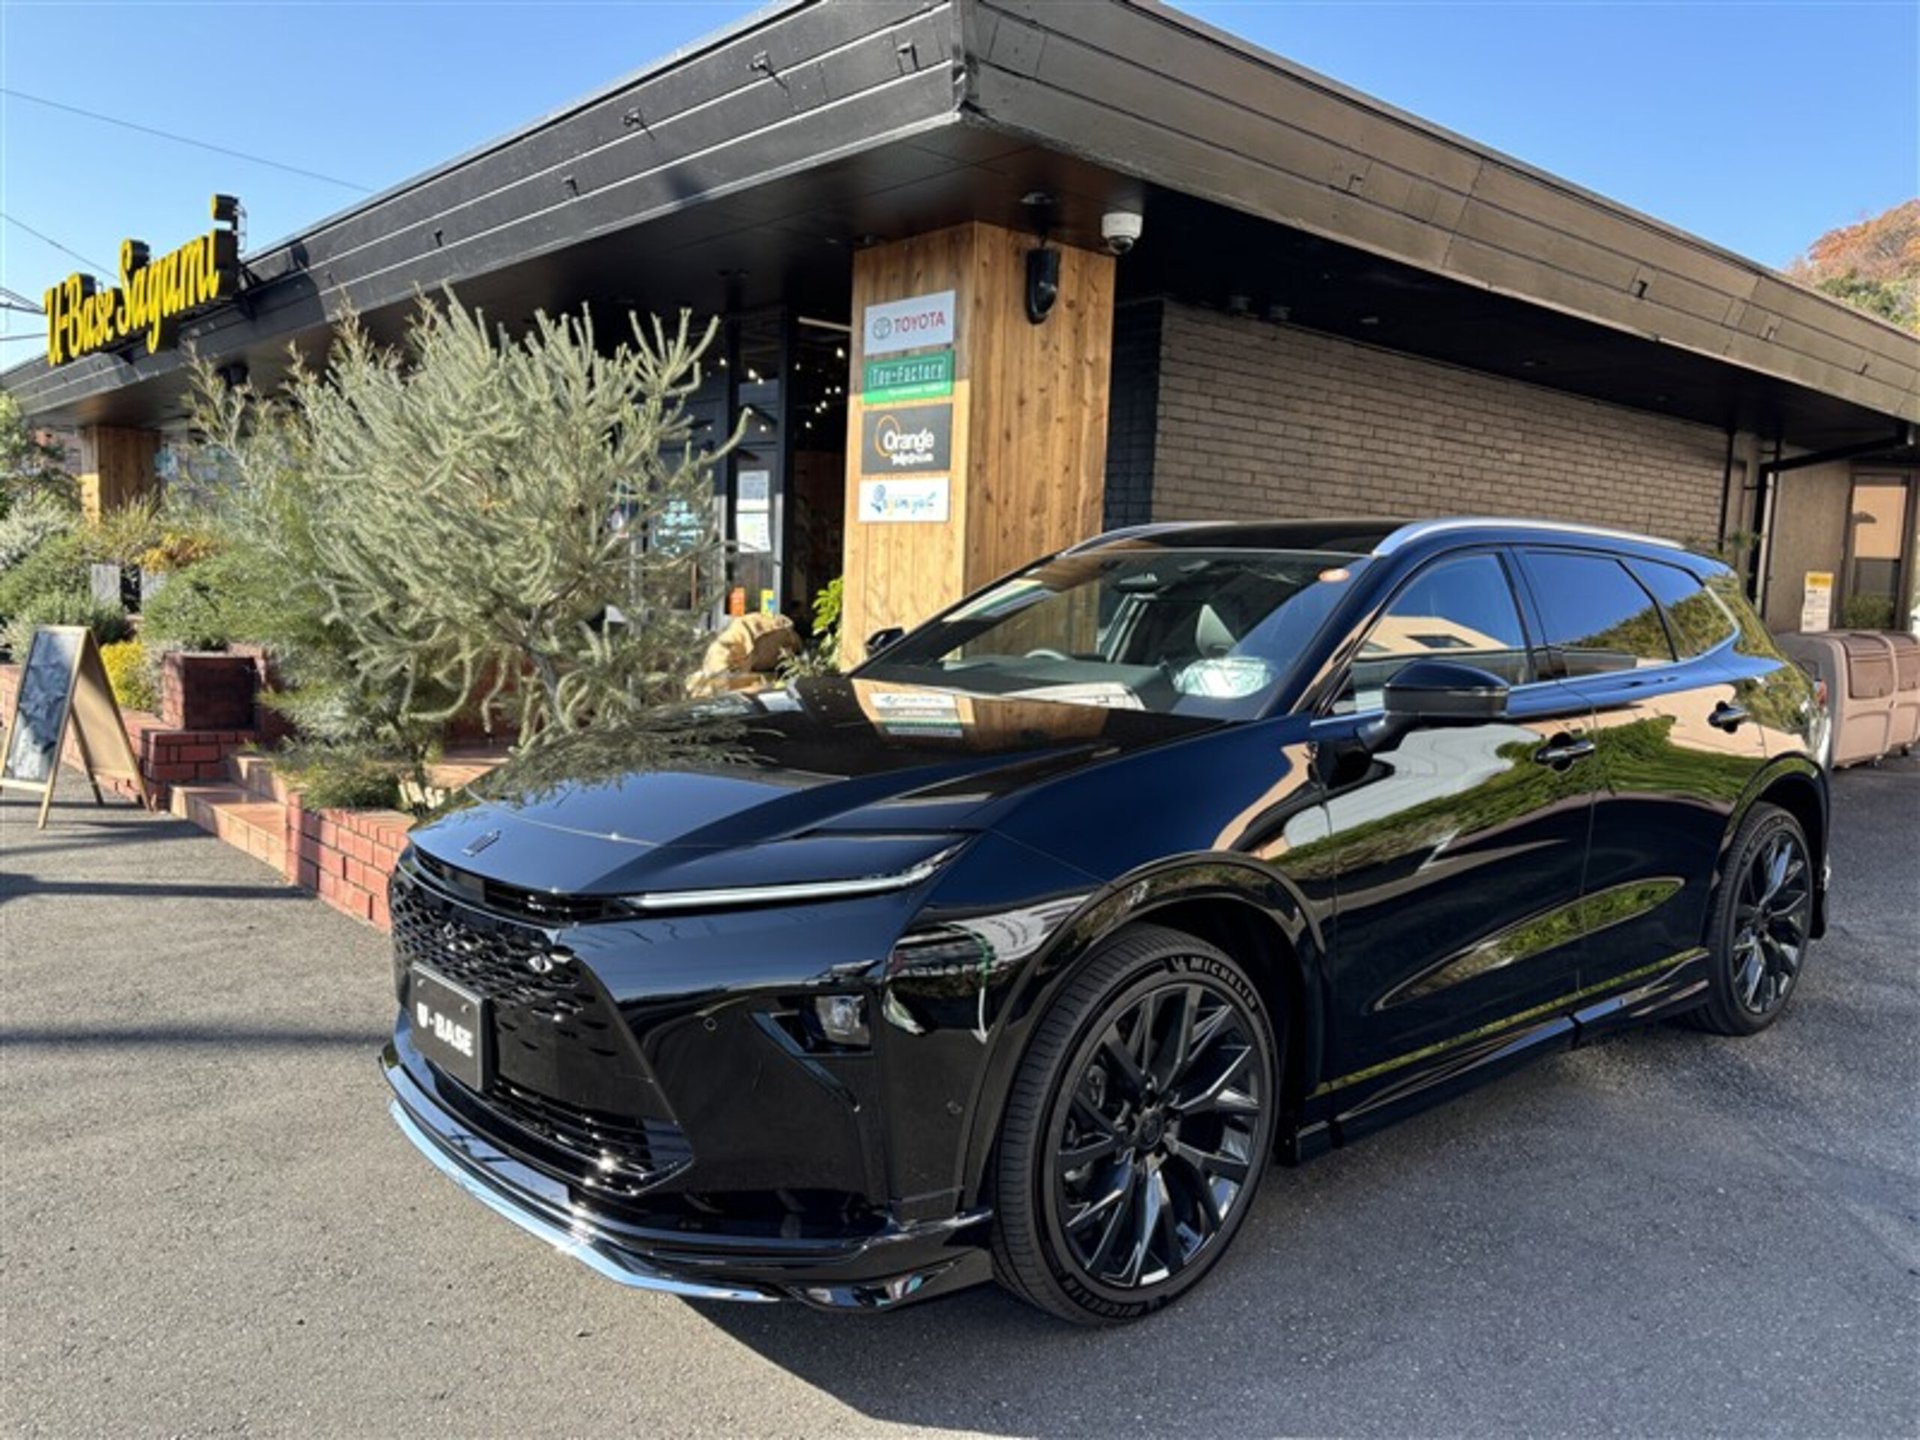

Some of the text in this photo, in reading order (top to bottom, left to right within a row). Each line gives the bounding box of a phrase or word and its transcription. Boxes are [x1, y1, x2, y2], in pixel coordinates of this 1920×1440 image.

[116, 193, 226, 355] Sagami
[893, 311, 946, 333] TOYOTA
[882, 427, 935, 453] Orange
[1190, 957, 1257, 1009] MICHELIN
